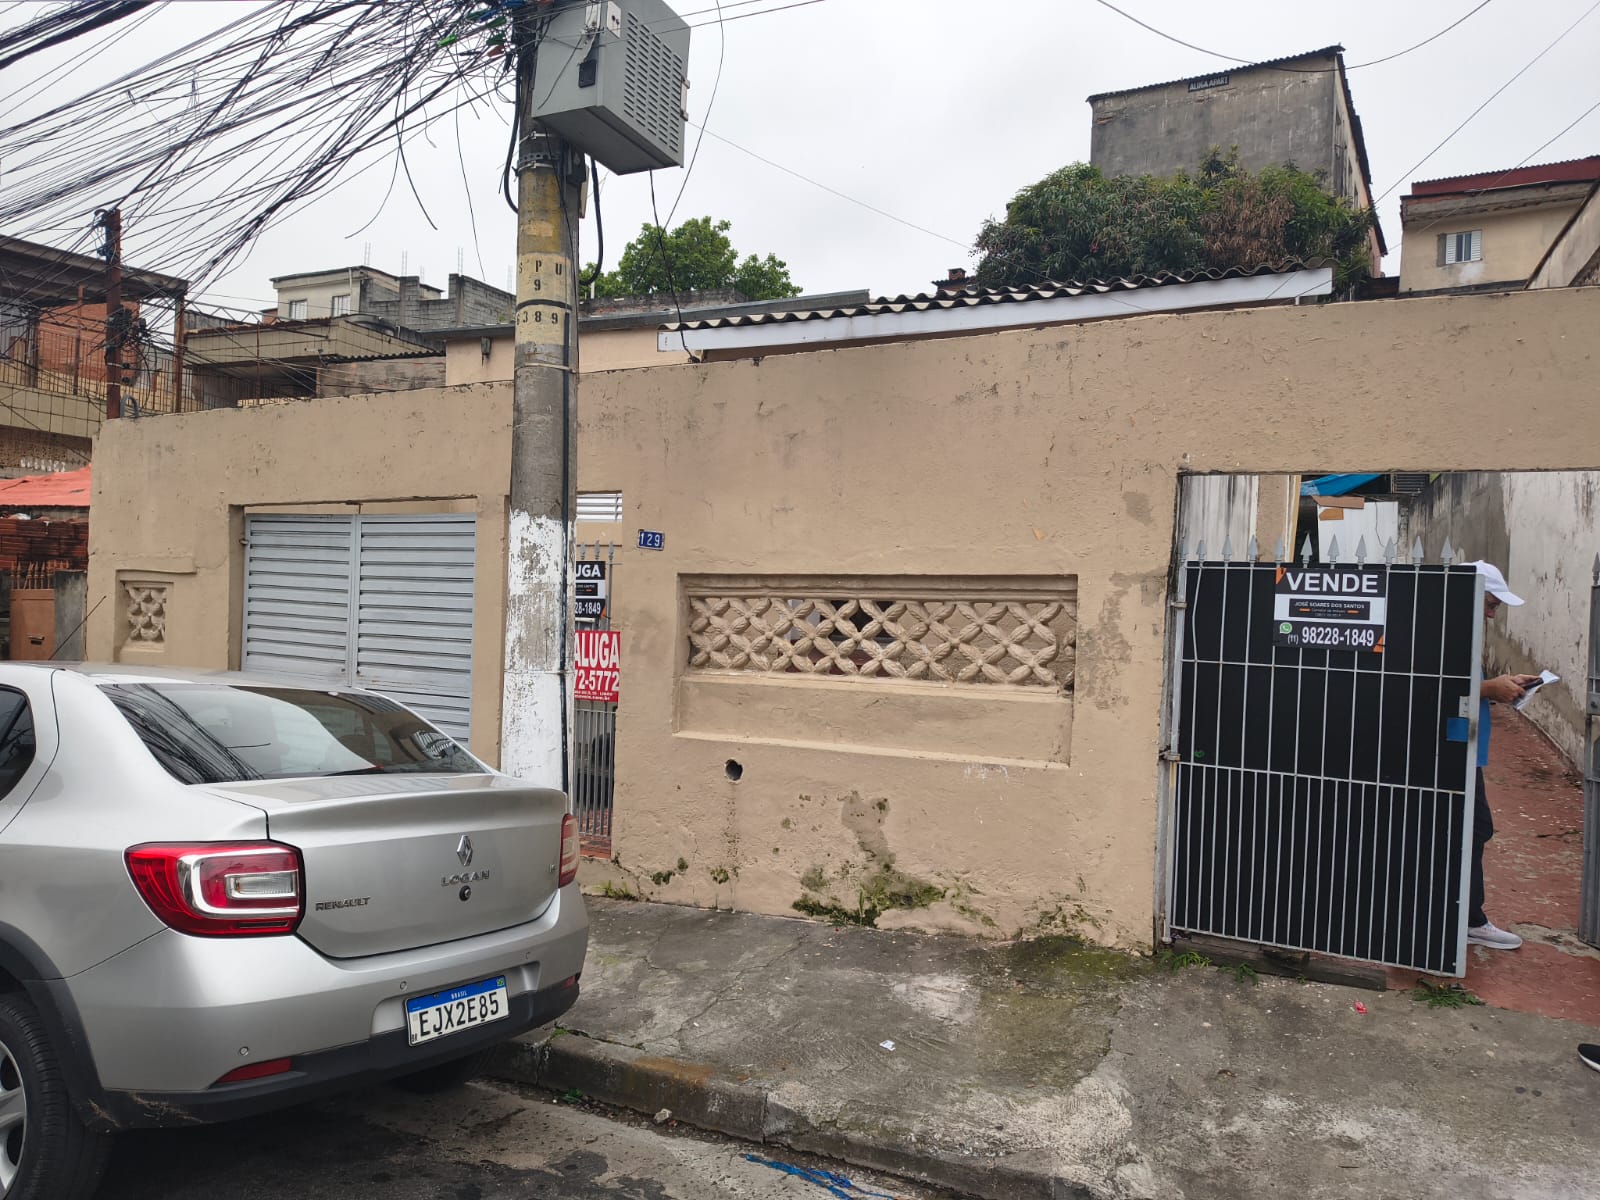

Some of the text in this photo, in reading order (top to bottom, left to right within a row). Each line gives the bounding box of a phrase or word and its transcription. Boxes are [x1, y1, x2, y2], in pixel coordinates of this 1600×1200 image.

[534, 279, 541, 291] 9
[640, 532, 660, 547] 129
[576, 564, 601, 577] UGA
[1286, 572, 1379, 593] VENDE
[575, 602, 601, 614] 28-1849
[1302, 626, 1375, 647] 98228-1849
[574, 632, 620, 669] ALUGA
[574, 669, 620, 691] 72-5772
[440, 870, 490, 887] LOGAN
[315, 896, 371, 911] RENAULT
[419, 992, 499, 1037] EJX2E85
